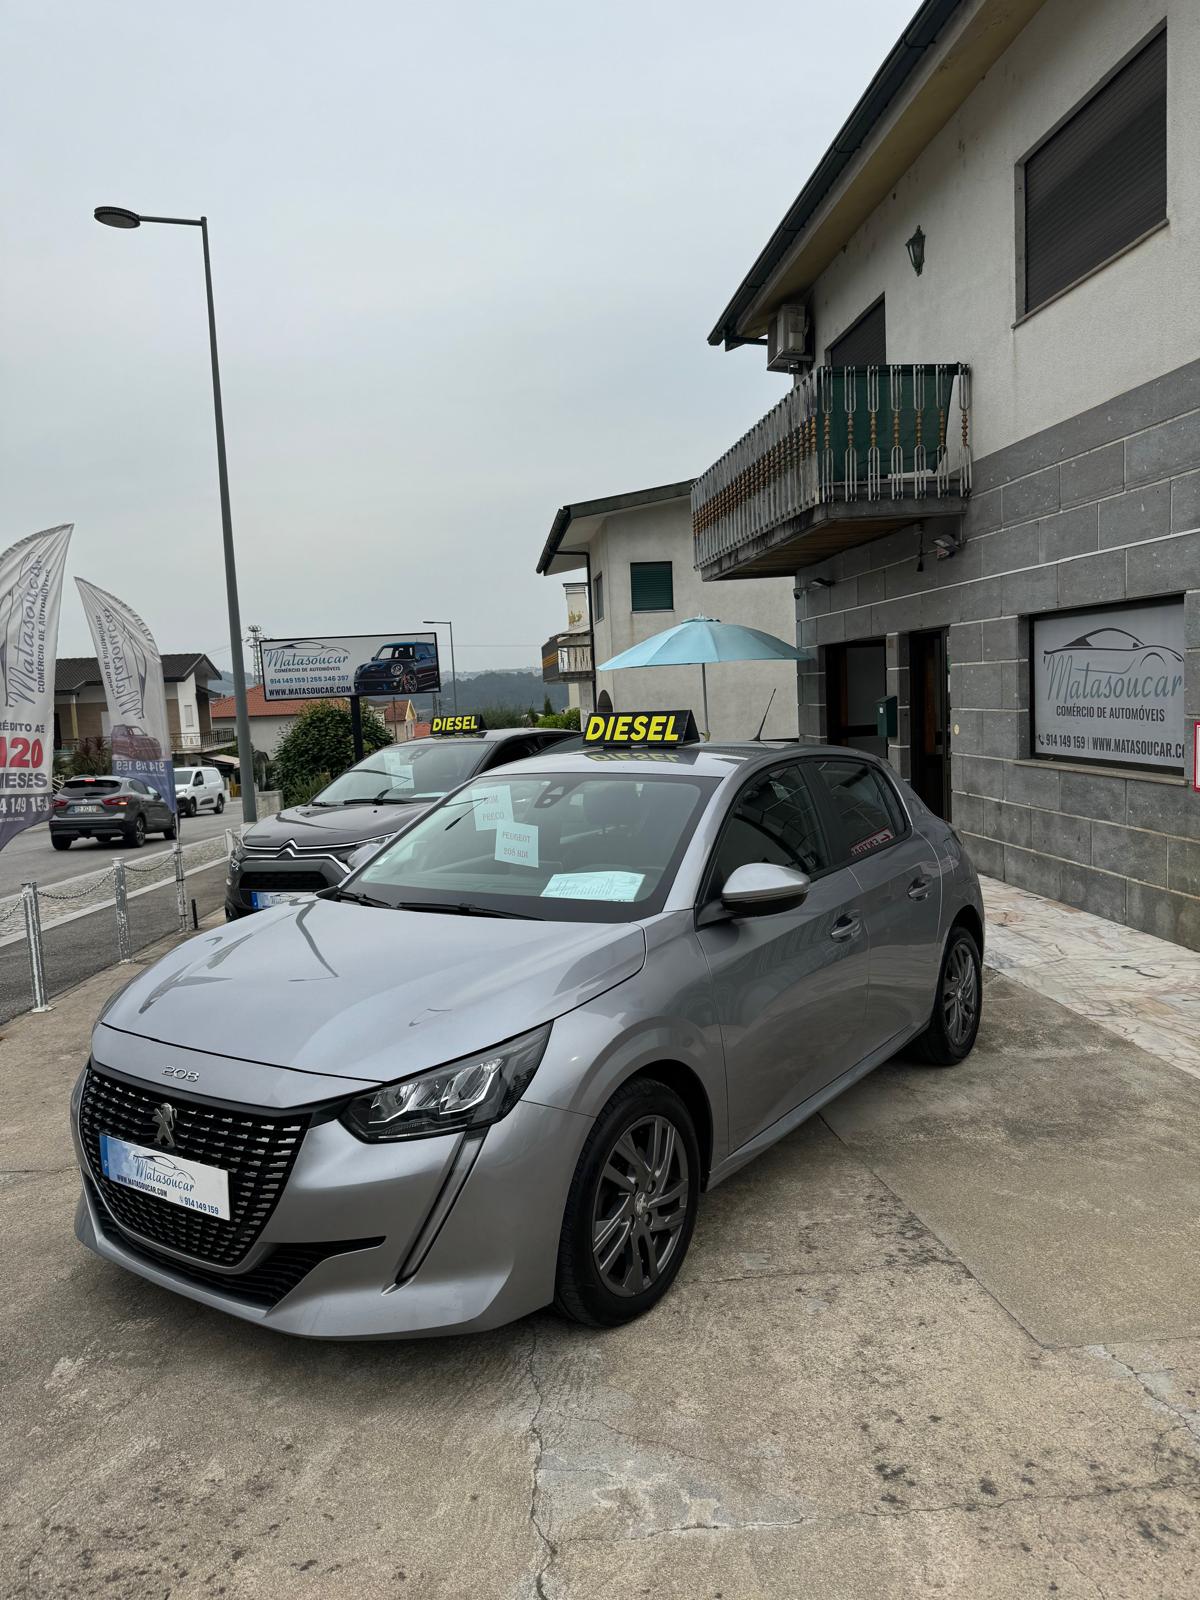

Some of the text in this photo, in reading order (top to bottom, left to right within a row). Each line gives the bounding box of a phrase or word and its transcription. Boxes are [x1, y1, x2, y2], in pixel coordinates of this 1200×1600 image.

[38, 629, 46, 642] DE
[36, 644, 45, 693] COMÉRCIO
[264, 650, 348, 668] Matasoucar
[1044, 655, 1182, 703] Matasoucar
[268, 686, 352, 696] WWW.MATASOUCAR.COM
[1056, 703, 1165, 722] COMÉRCIO DE AUTOMÓVEIS
[432, 716, 478, 731] DIESEL
[585, 716, 679, 740] DIESEL
[1046, 734, 1058, 747] 914
[1059, 735, 1071, 748] 149
[1074, 736, 1086, 749] 159
[0, 736, 43, 768] 120
[10, 797, 26, 814] 149
[162, 1066, 200, 1082] 208
[132, 1157, 194, 1192] Matasoucar
[116, 1174, 168, 1198] WWW.MATASOUCAR.COM
[184, 1196, 218, 1215] 914 149 159
